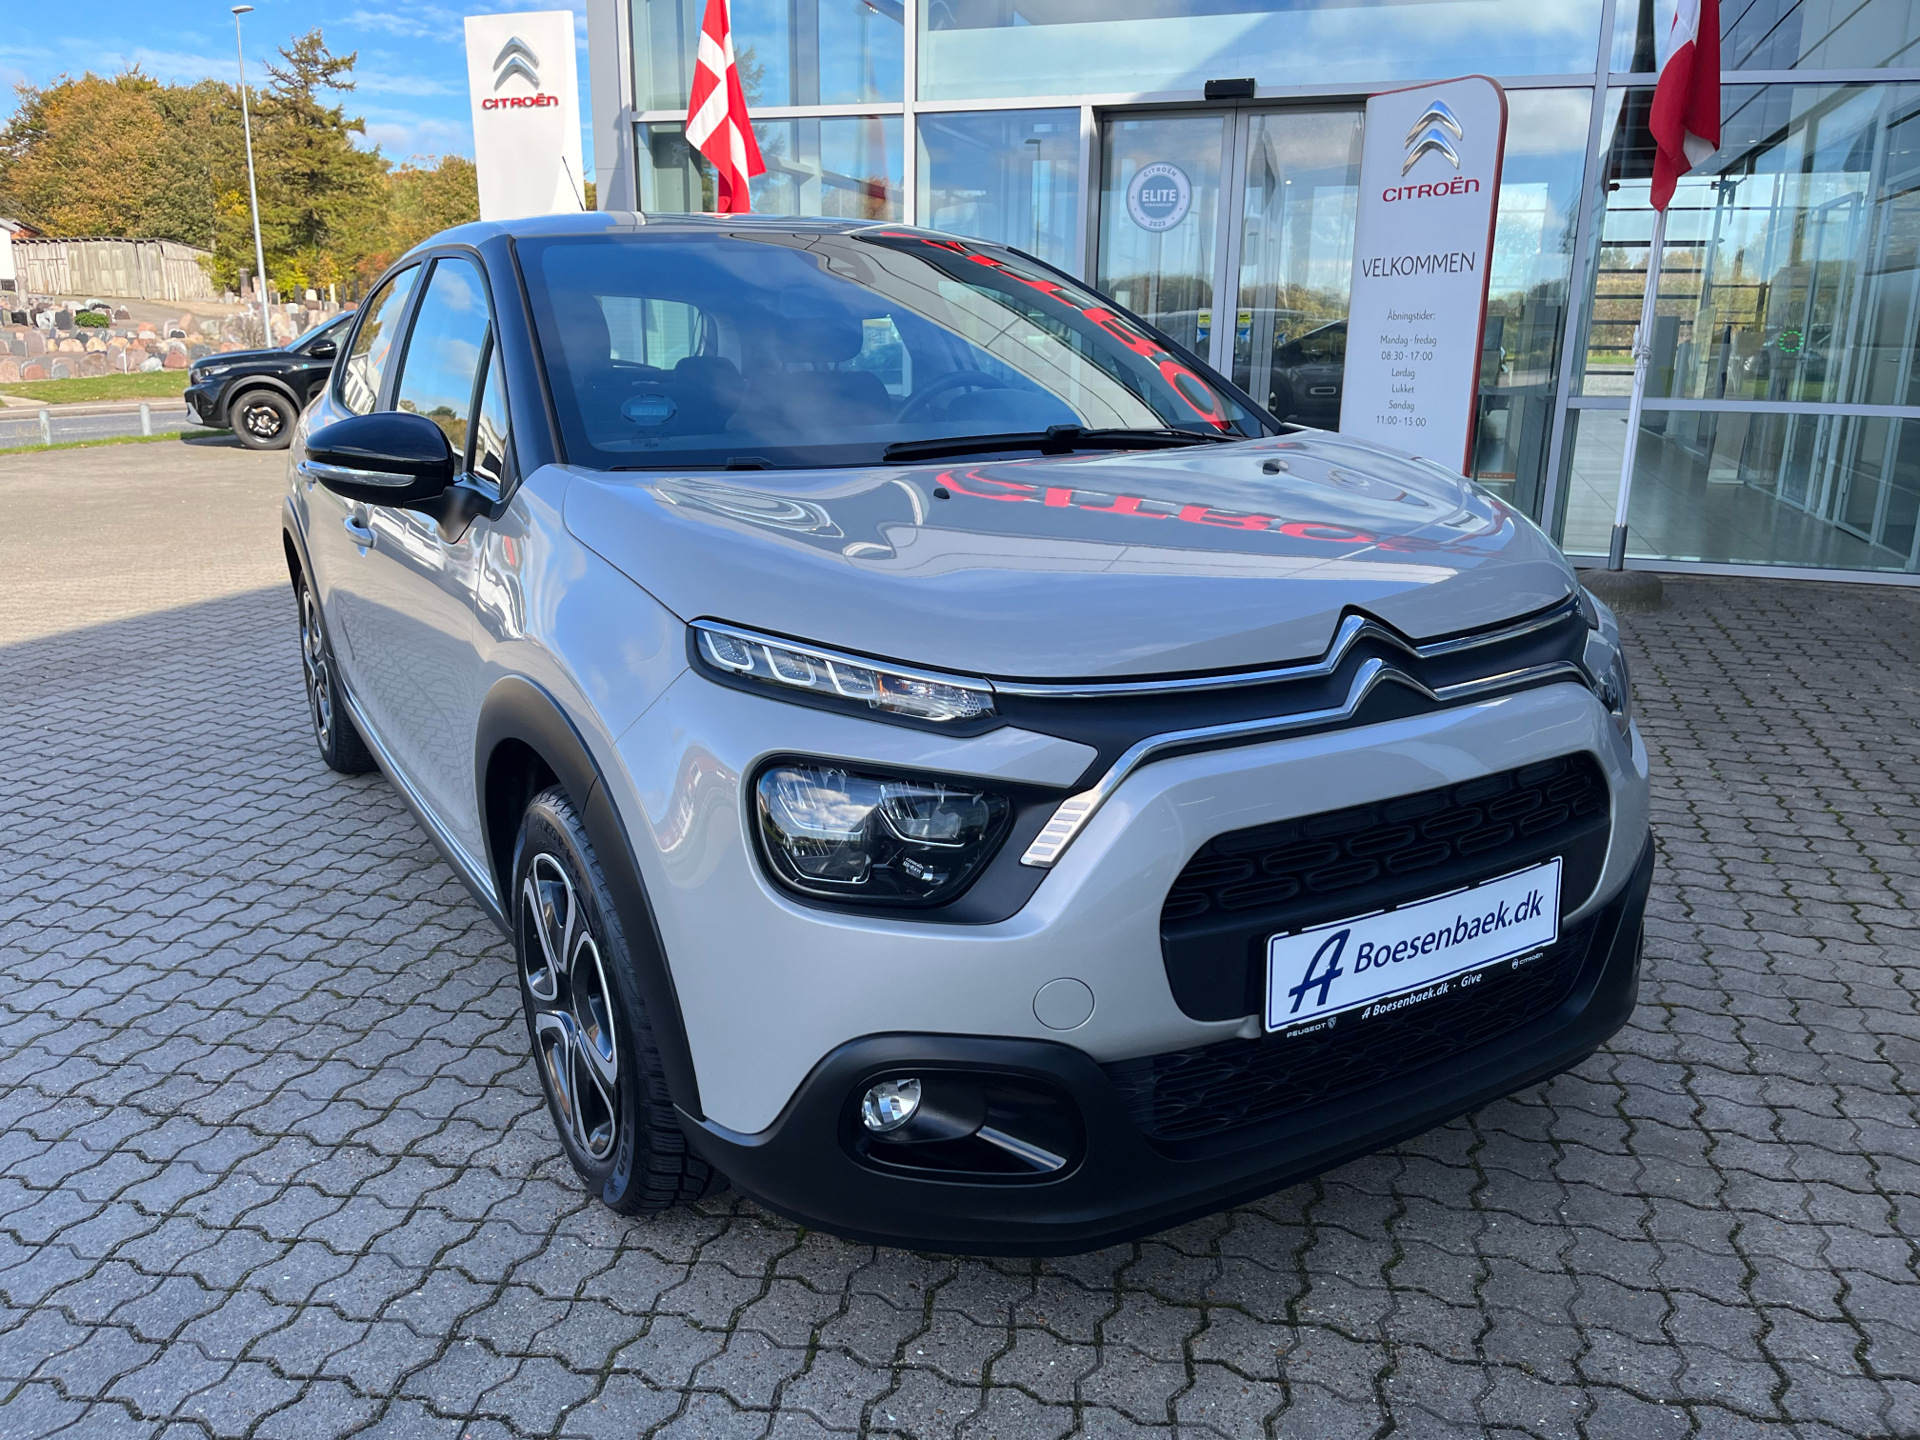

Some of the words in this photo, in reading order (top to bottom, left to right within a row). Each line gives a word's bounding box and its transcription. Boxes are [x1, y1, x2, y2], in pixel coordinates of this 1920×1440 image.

[482, 93, 559, 110] CITROËN
[1143, 166, 1177, 178] CITROËN
[1142, 189, 1177, 202] ELITE
[1382, 176, 1480, 203] CITROËN
[1362, 251, 1476, 278] VELKOMMEN
[1387, 308, 1436, 324] Åbningstider:
[1380, 334, 1408, 348] Mandag
[1414, 333, 1437, 348] fredag
[1381, 351, 1404, 361] 08:30
[1410, 351, 1433, 361] 17:00
[1391, 367, 1416, 380] Lørdag
[1391, 383, 1415, 394] Lukket
[1388, 399, 1415, 413] Søndag
[1376, 415, 1398, 425] 11:00
[1404, 416, 1427, 427] 15:00
[1353, 889, 1545, 974] Boesenbaek.dk
[1372, 982, 1450, 1016] Boesenbaek.dk
[1460, 973, 1483, 988] Give
[1286, 1022, 1327, 1038] PEUGEOT
